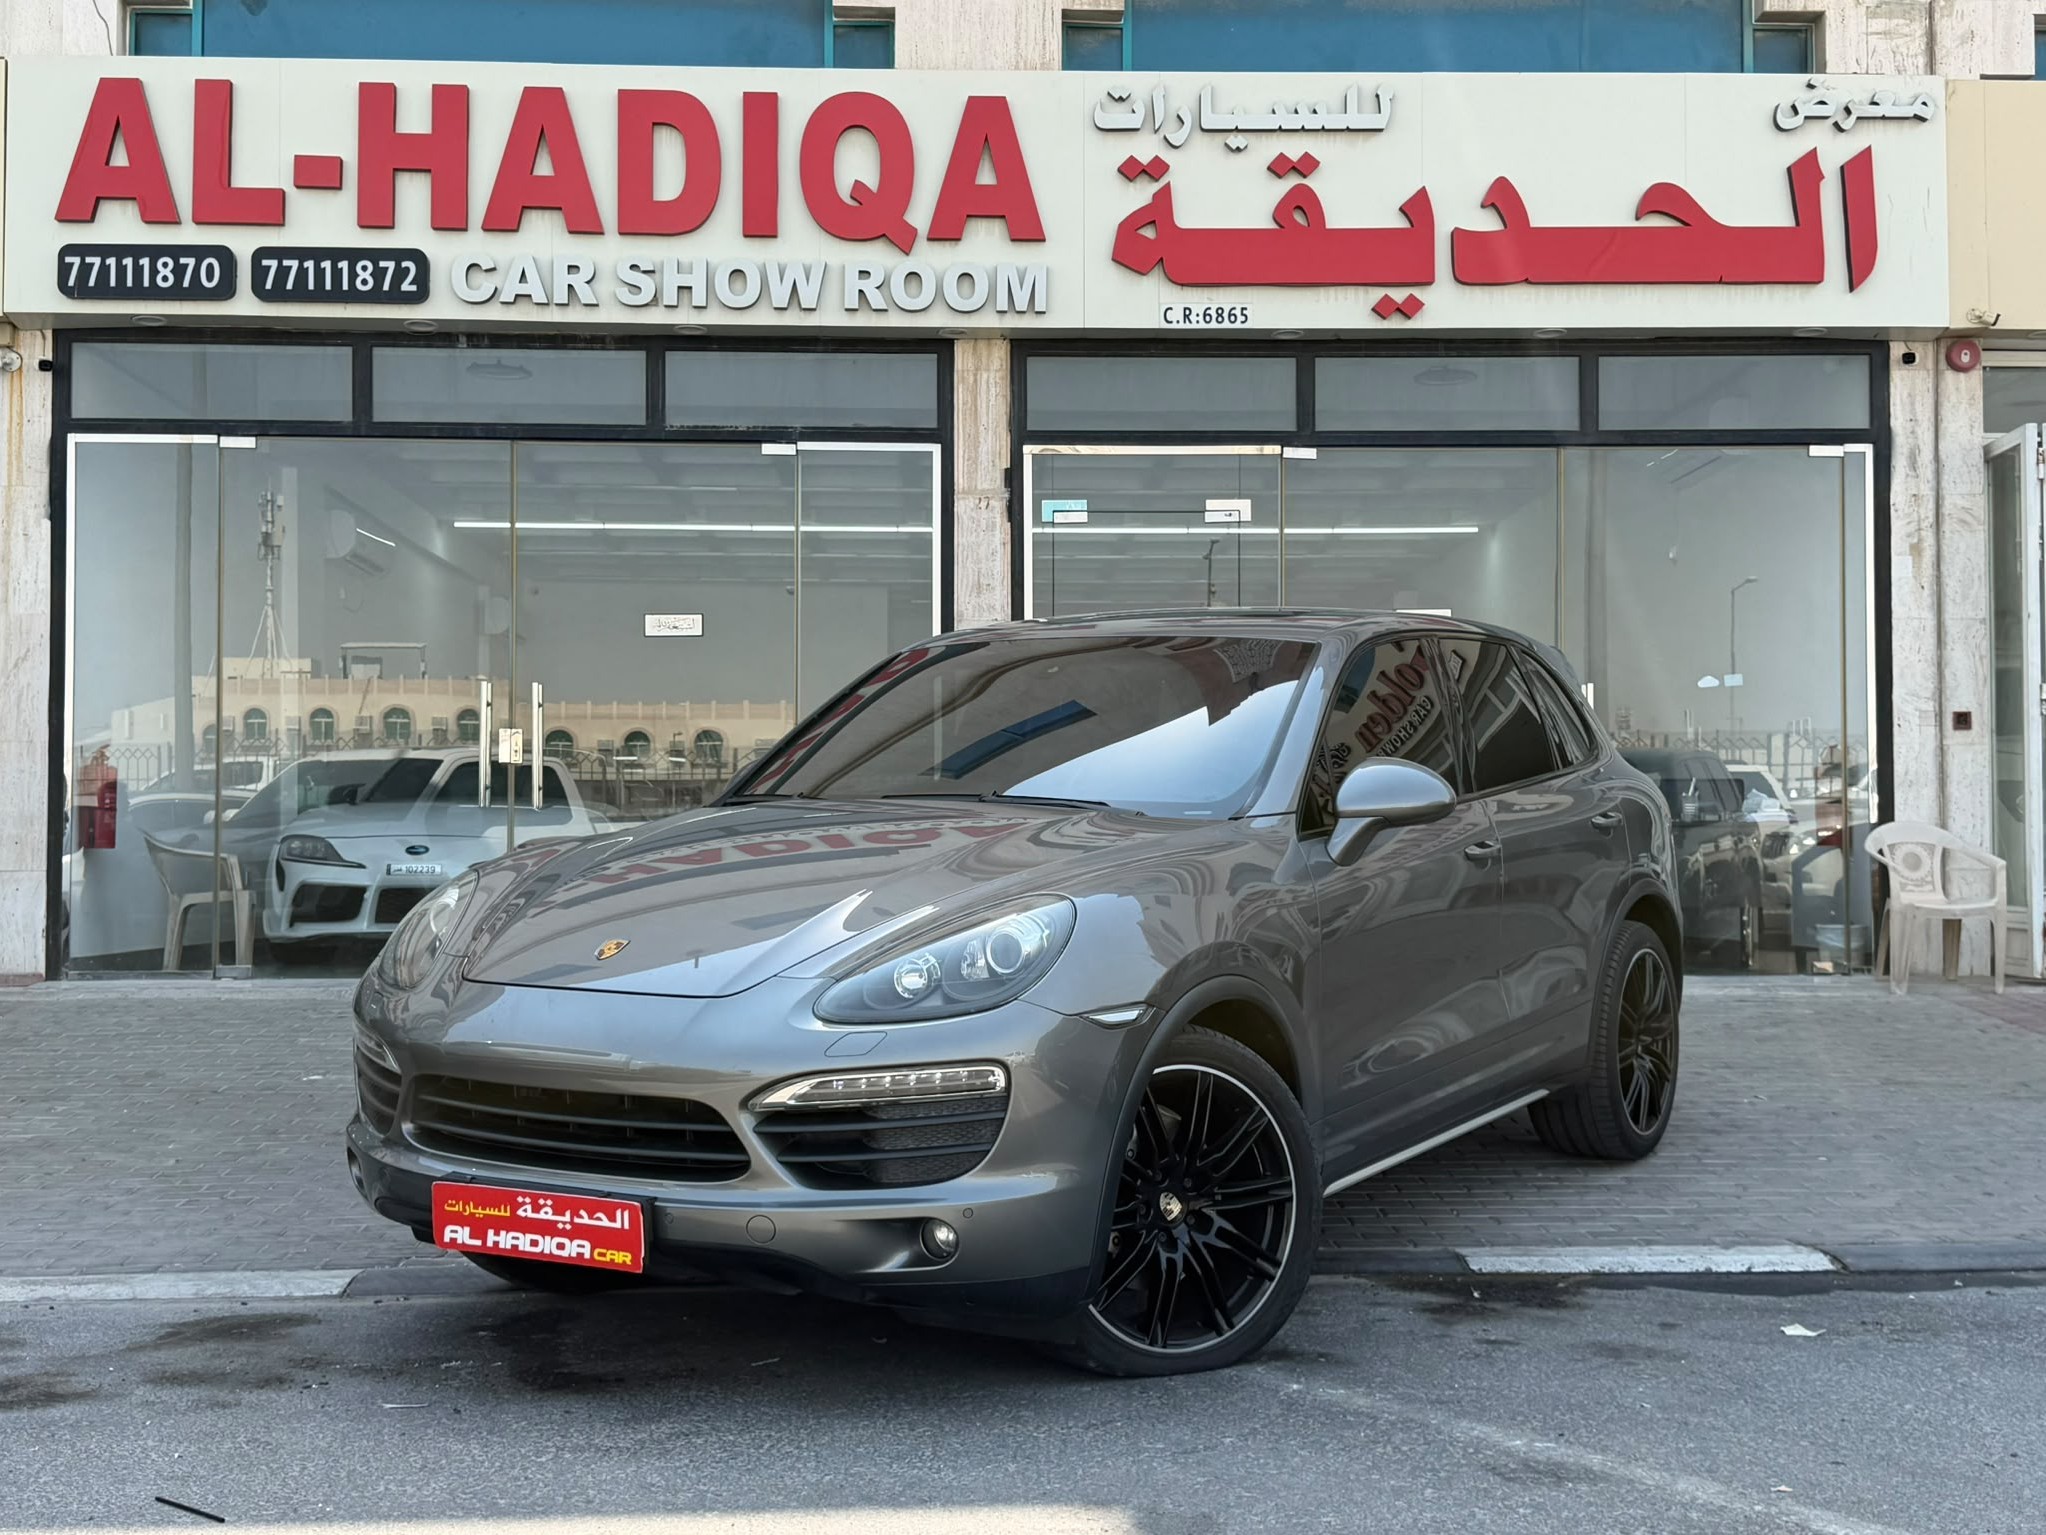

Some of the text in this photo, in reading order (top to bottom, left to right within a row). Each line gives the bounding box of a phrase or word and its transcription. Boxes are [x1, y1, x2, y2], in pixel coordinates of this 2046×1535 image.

[1093, 82, 1396, 152] للسيارات
[1772, 76, 1935, 133] معرض
[55, 77, 1046, 254] AL-HADIQA
[1111, 144, 1879, 320] الحديقة
[64, 256, 221, 289] 77111870
[260, 259, 418, 292] 77111872
[450, 254, 1049, 314] CAR SHOW ROOM
[1162, 306, 1249, 326] C.R:6865
[444, 1195, 631, 1230] الحديقة للسيارات
[443, 1224, 632, 1265] AL HADIQA CAR
